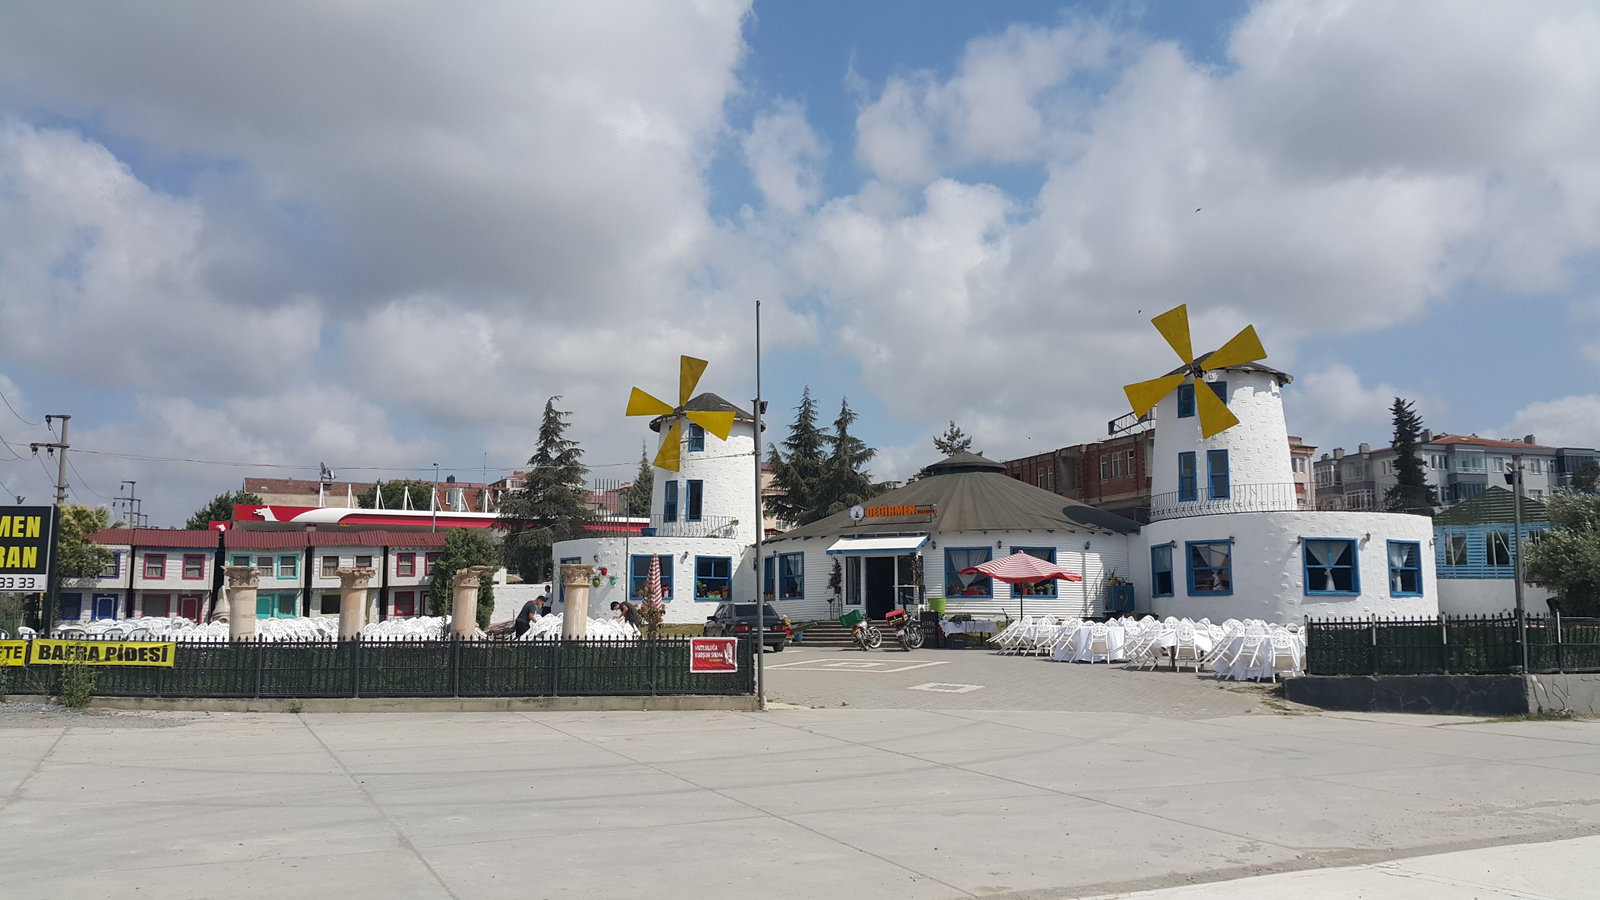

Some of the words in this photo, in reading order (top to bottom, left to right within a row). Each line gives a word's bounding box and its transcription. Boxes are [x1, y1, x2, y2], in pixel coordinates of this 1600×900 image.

[18, 577, 35, 588] 33
[38, 644, 100, 661] BAFRA
[104, 643, 169, 663] PİDESİ
